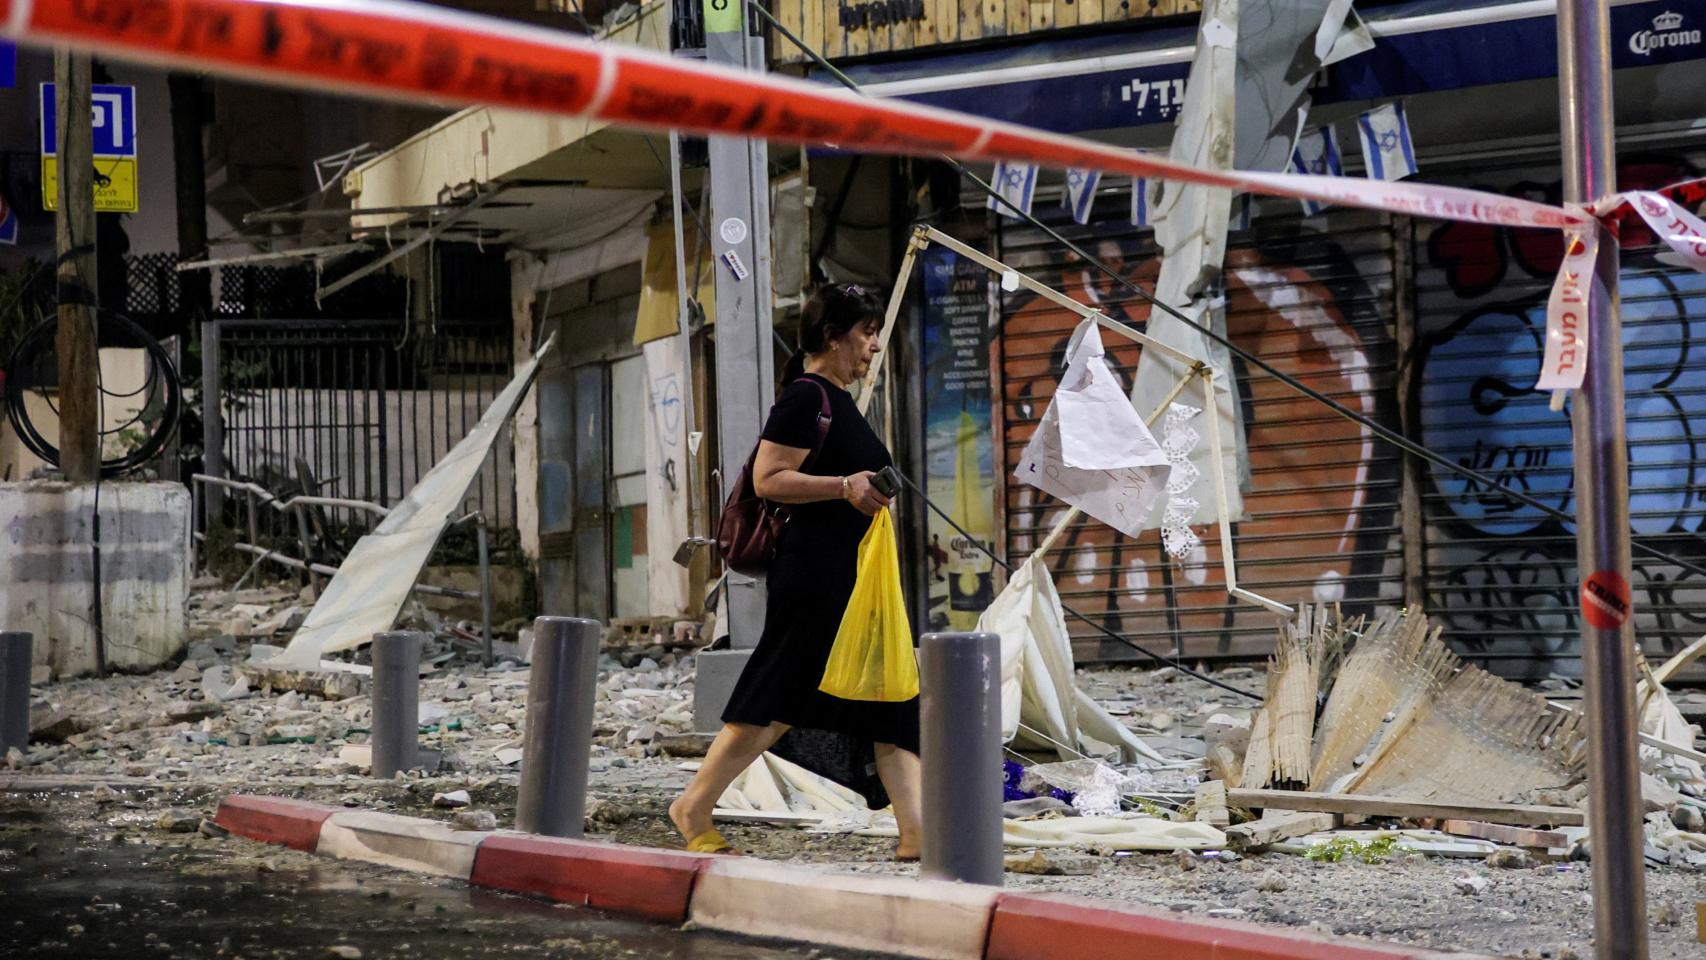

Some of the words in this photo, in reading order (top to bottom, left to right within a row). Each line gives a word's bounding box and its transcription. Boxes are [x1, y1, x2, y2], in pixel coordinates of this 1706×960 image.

[1629, 30, 1701, 56] Corona
[953, 280, 977, 292] ATM
[1557, 312, 1578, 376] מעבר
[960, 550, 979, 559] Extra
